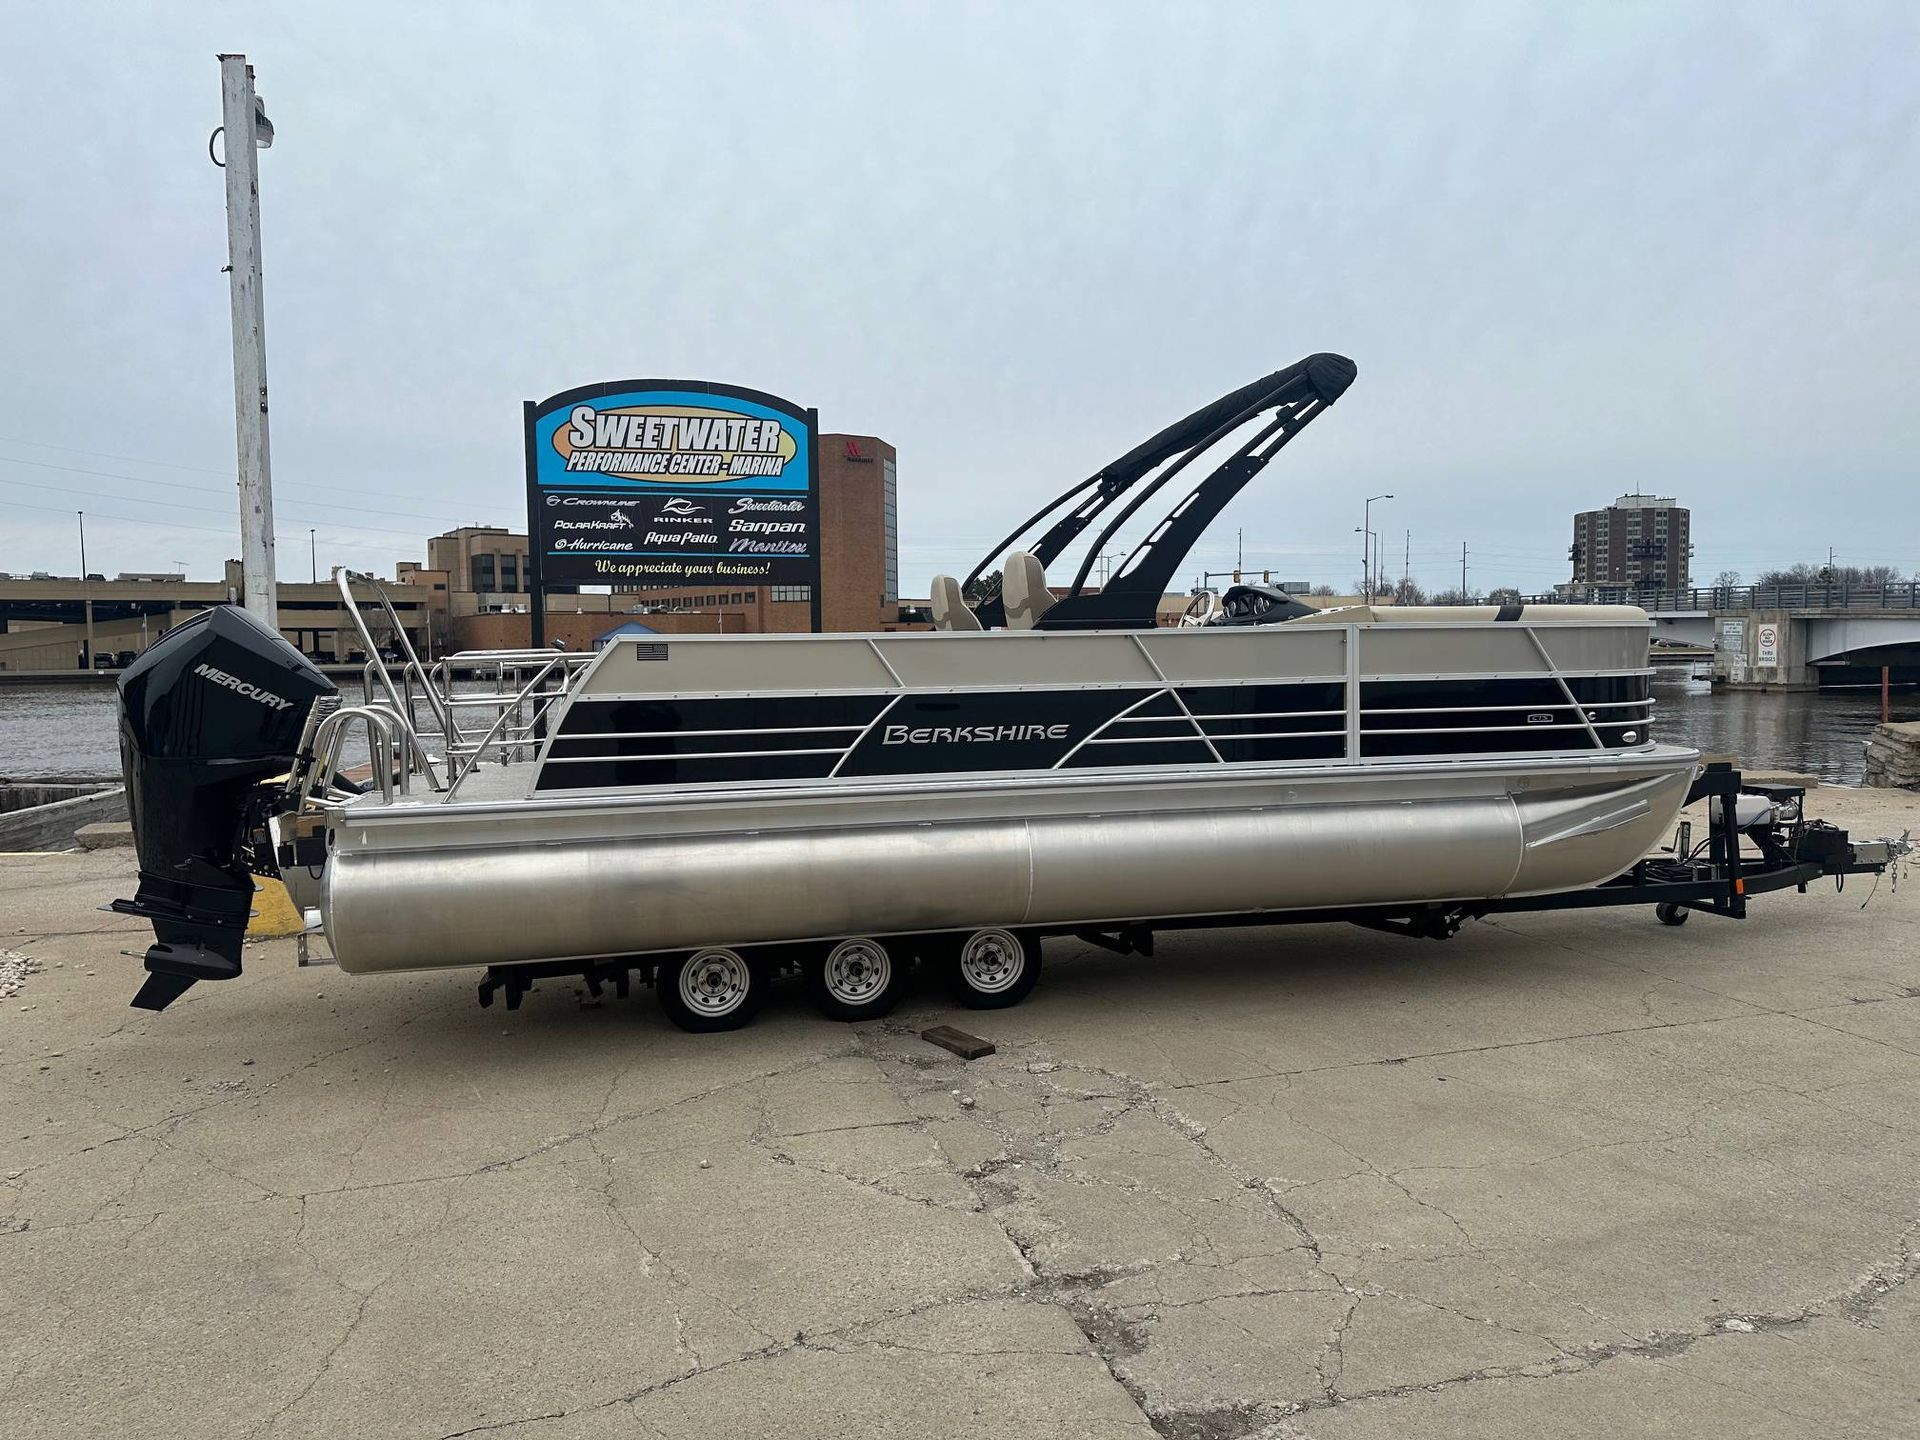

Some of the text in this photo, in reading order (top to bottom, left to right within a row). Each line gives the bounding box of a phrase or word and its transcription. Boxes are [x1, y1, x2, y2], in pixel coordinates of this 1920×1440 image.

[569, 406, 780, 452] SWEETWATER
[567, 451, 670, 474] PERFORMANCE
[669, 453, 723, 475] CENTER
[728, 455, 785, 476] MARINA
[728, 497, 805, 514] Sweetwater
[728, 519, 806, 535] Sanpan
[567, 538, 634, 551] Hurricane
[728, 538, 807, 553] Manitou
[595, 559, 771, 577] We appreciate your business!
[193, 663, 295, 711] MERCURY
[882, 724, 1070, 745] BERKSHIRE
